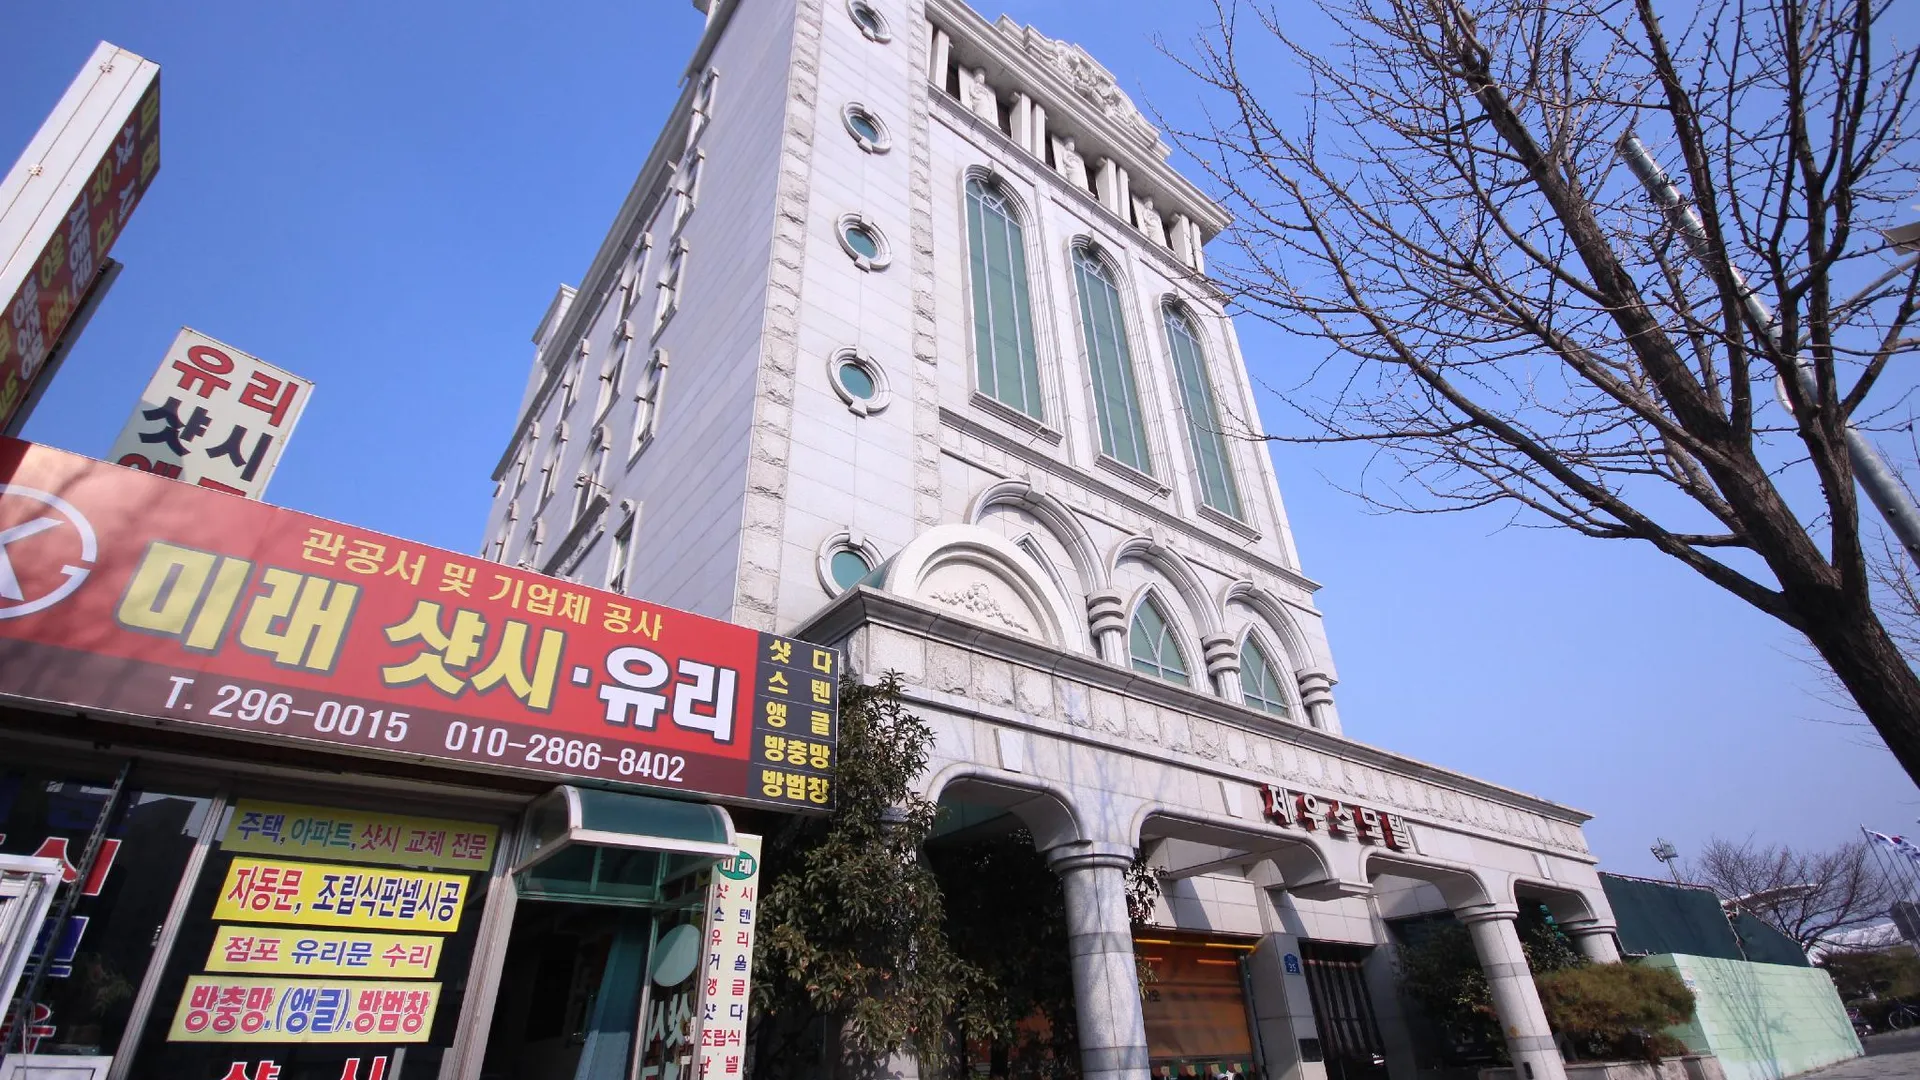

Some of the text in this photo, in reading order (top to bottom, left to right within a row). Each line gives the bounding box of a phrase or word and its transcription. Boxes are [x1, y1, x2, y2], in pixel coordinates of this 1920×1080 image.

[172, 345, 299, 428] 유리
[139, 397, 273, 482] 샷시
[302, 528, 663, 642] 관공서 및 기업체 공사
[116, 541, 362, 672] 미래
[769, 639, 832, 674] 샷다
[768, 671, 831, 705] 스텐
[165, 676, 687, 783] T. 296-0015 010-2866-8402
[764, 735, 830, 769] 방충망
[762, 769, 829, 803] 방범창
[360, 824, 401, 853] 샷시
[404, 829, 446, 857] 교체
[451, 832, 487, 860] 전문
[722, 856, 753, 875] 미래
[716, 884, 753, 902] 샷시
[714, 906, 751, 924] 스텐
[224, 936, 434, 969] 점포 유리문 수리
[712, 929, 749, 947] 유리
[702, 1029, 741, 1047] 조립식
